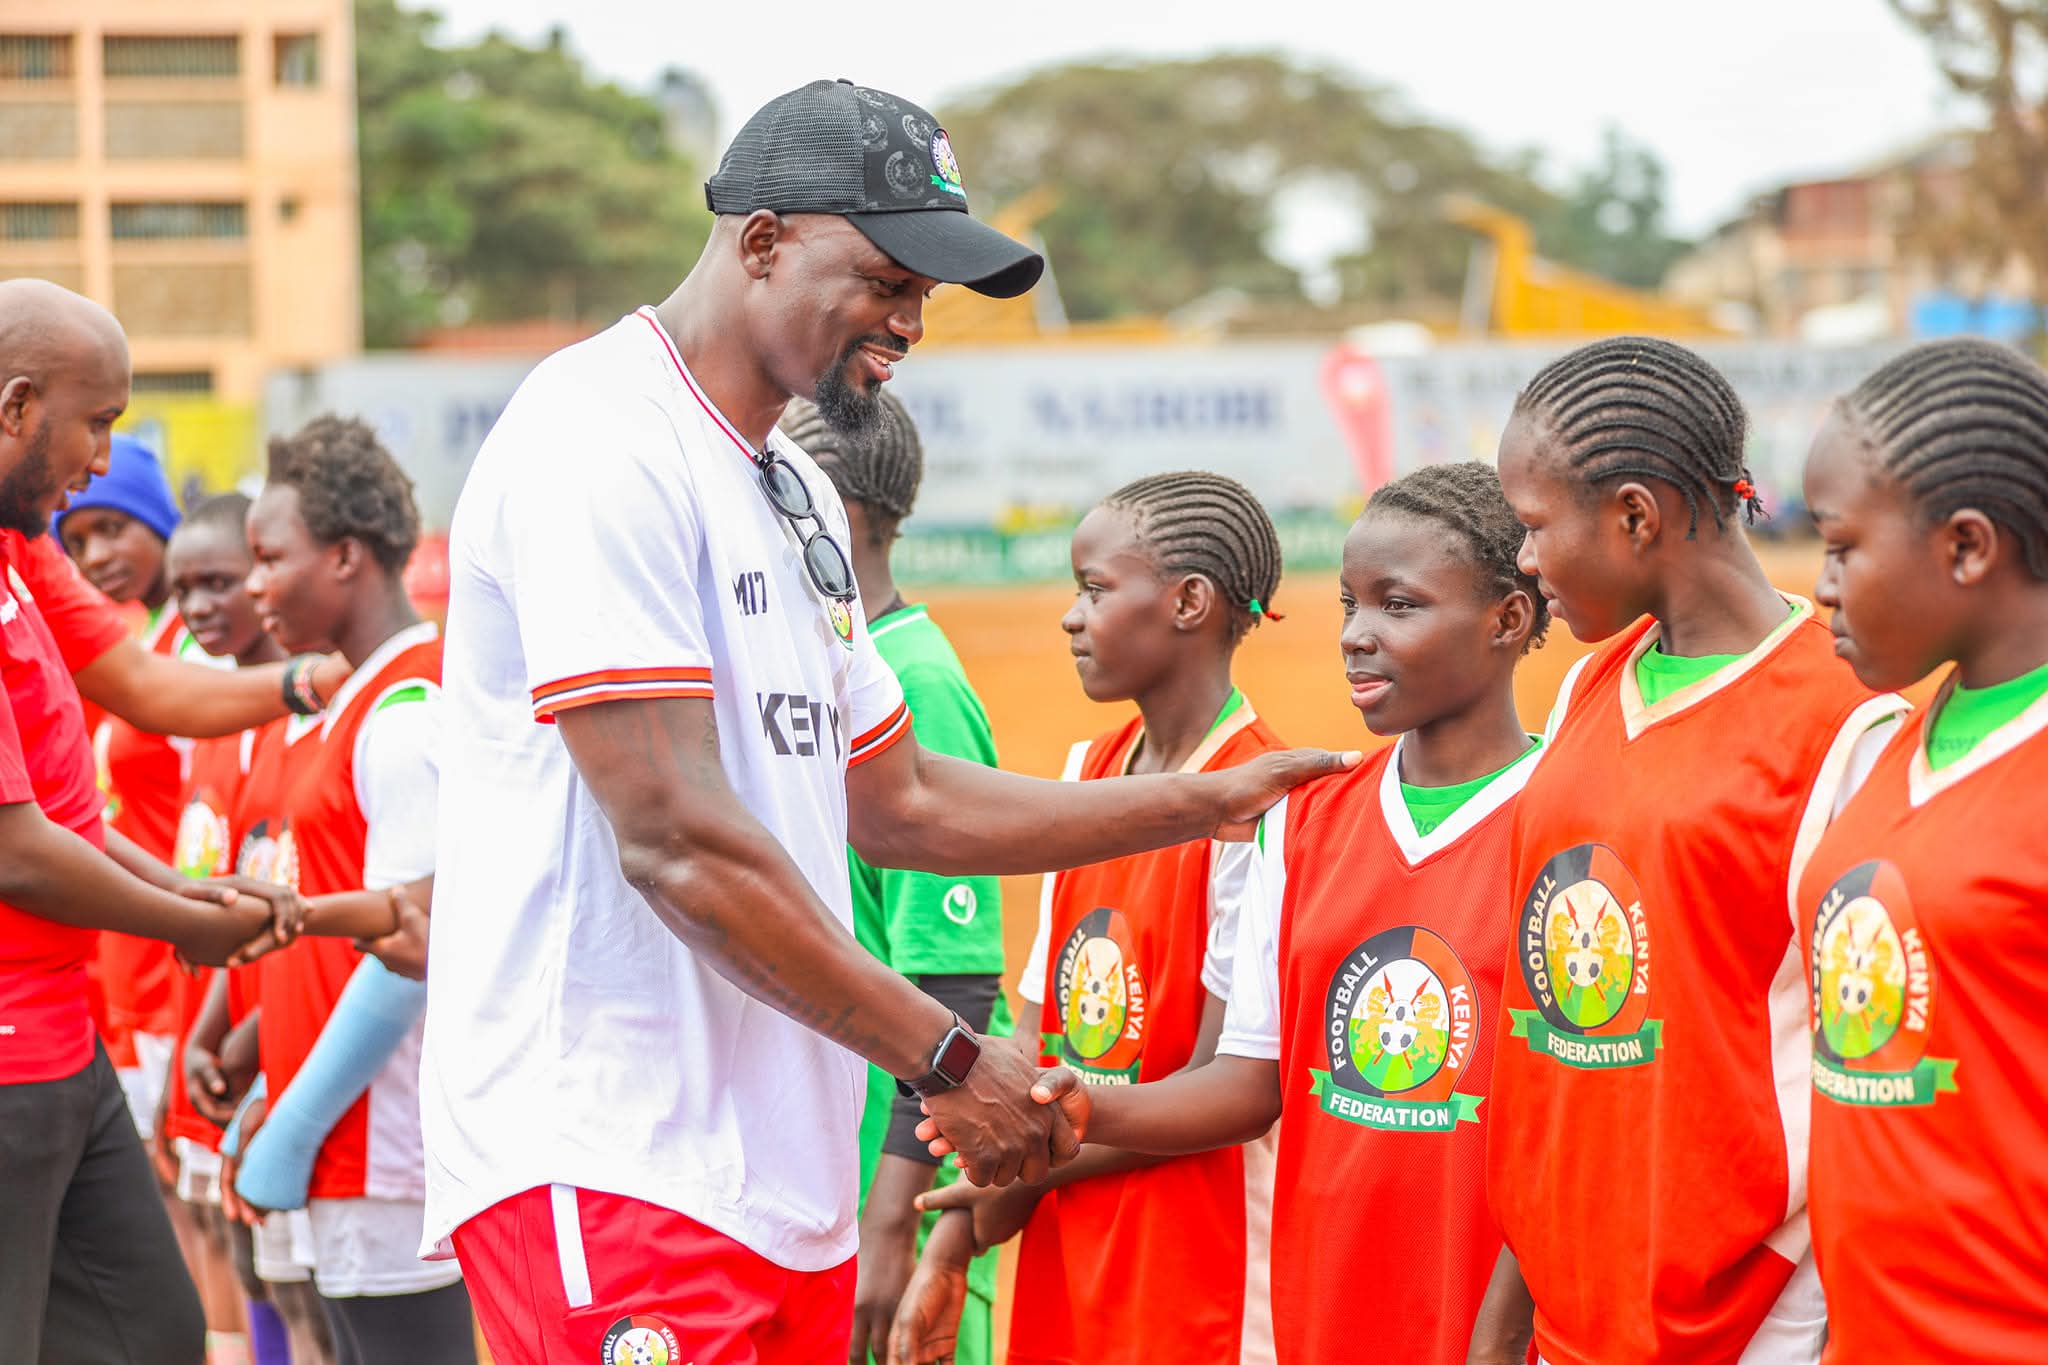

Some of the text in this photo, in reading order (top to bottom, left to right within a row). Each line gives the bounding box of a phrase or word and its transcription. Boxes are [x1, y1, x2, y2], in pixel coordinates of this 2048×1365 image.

[1526, 875, 1557, 1008] FOOTBALL
[1628, 900, 1649, 995] KENYA
[1902, 928, 1929, 1032] KENYA
[1126, 964, 1144, 1040] KENYA
[1331, 951, 1379, 1071] FOOTBALL
[1447, 984, 1470, 1069] KENYA
[1547, 1032, 1643, 1064] FEDERATION
[1328, 1093, 1450, 1128] FEDERATION
[660, 1326, 679, 1361] KENYA
